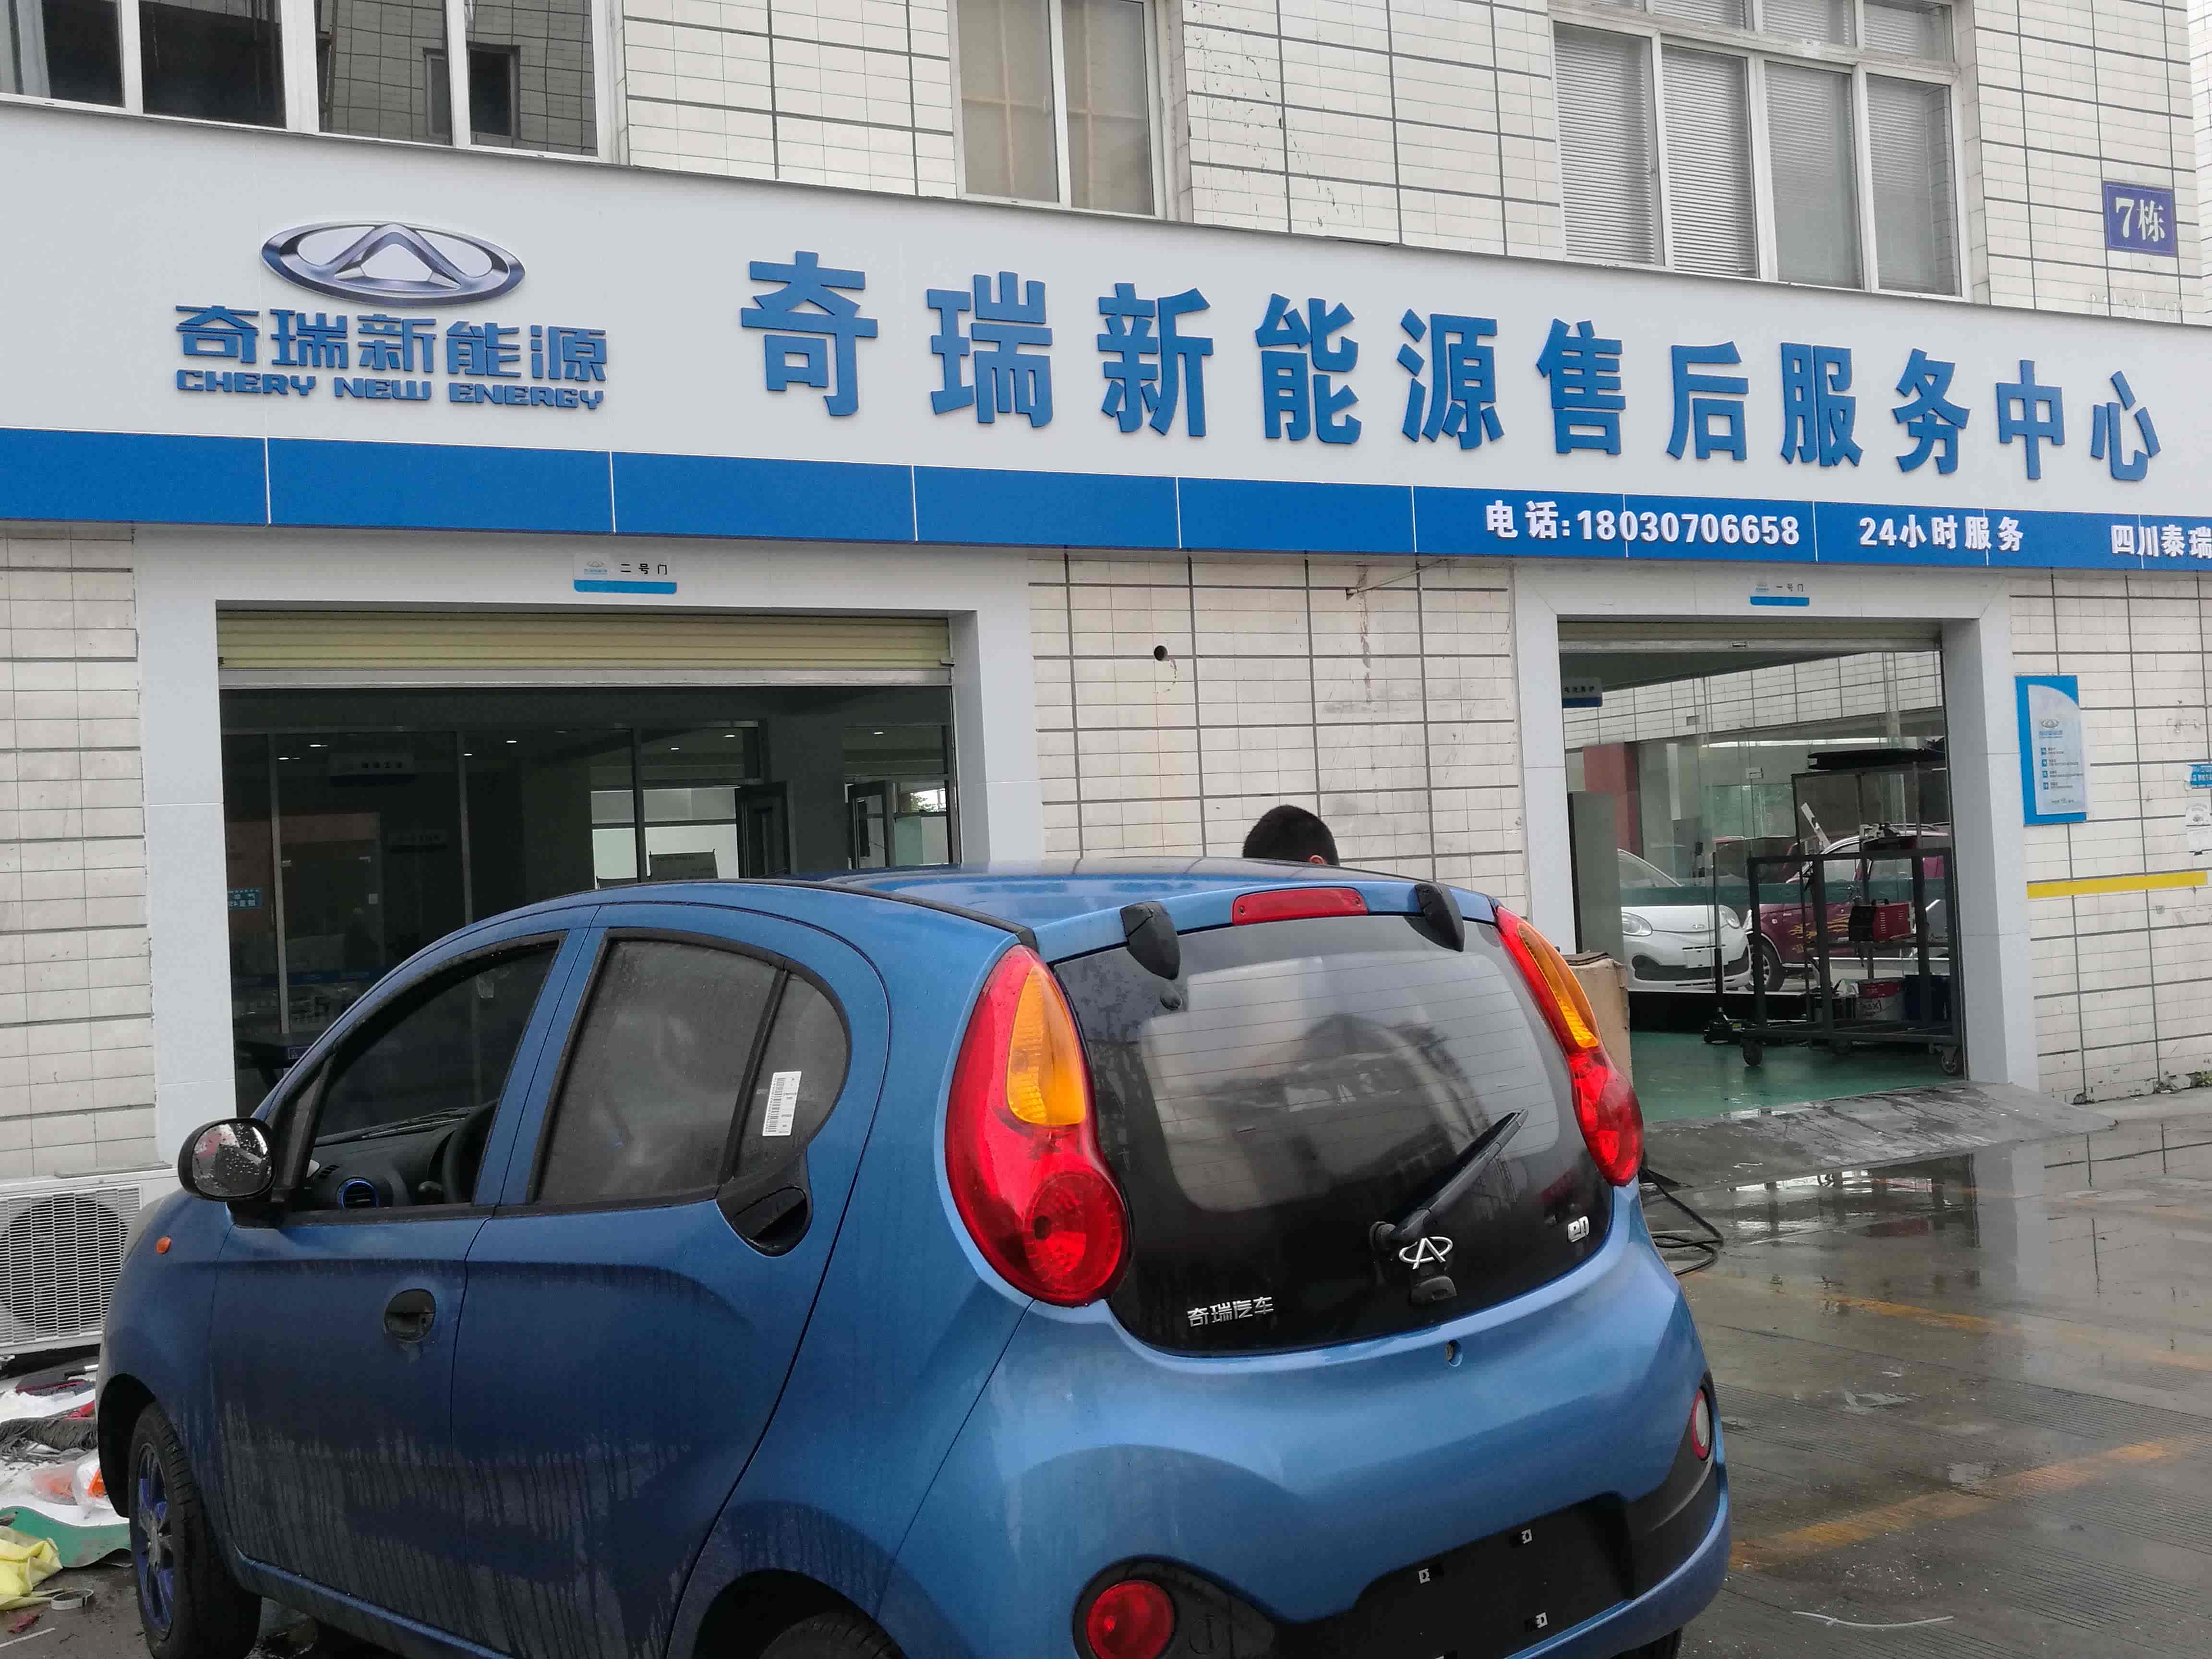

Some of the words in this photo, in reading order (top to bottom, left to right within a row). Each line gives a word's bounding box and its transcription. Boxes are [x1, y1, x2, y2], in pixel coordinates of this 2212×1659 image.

[2116, 197, 2165, 242] 7栋
[175, 305, 607, 383] 奇瑞新能源
[741, 250, 2162, 480] 奇瑞新能源售后服务中心
[176, 369, 316, 397] CHERY
[333, 377, 432, 401] NEW
[449, 382, 604, 409] ENERGY
[1485, 500, 1799, 545] 电话:18030706658
[1859, 514, 2024, 552] 24小时服务
[2111, 524, 2212, 559] 四川泰瑞
[620, 563, 668, 576] 二号门
[1776, 583, 1804, 592] 一号门
[1187, 1296, 1274, 1327] 奇瑞汽车
